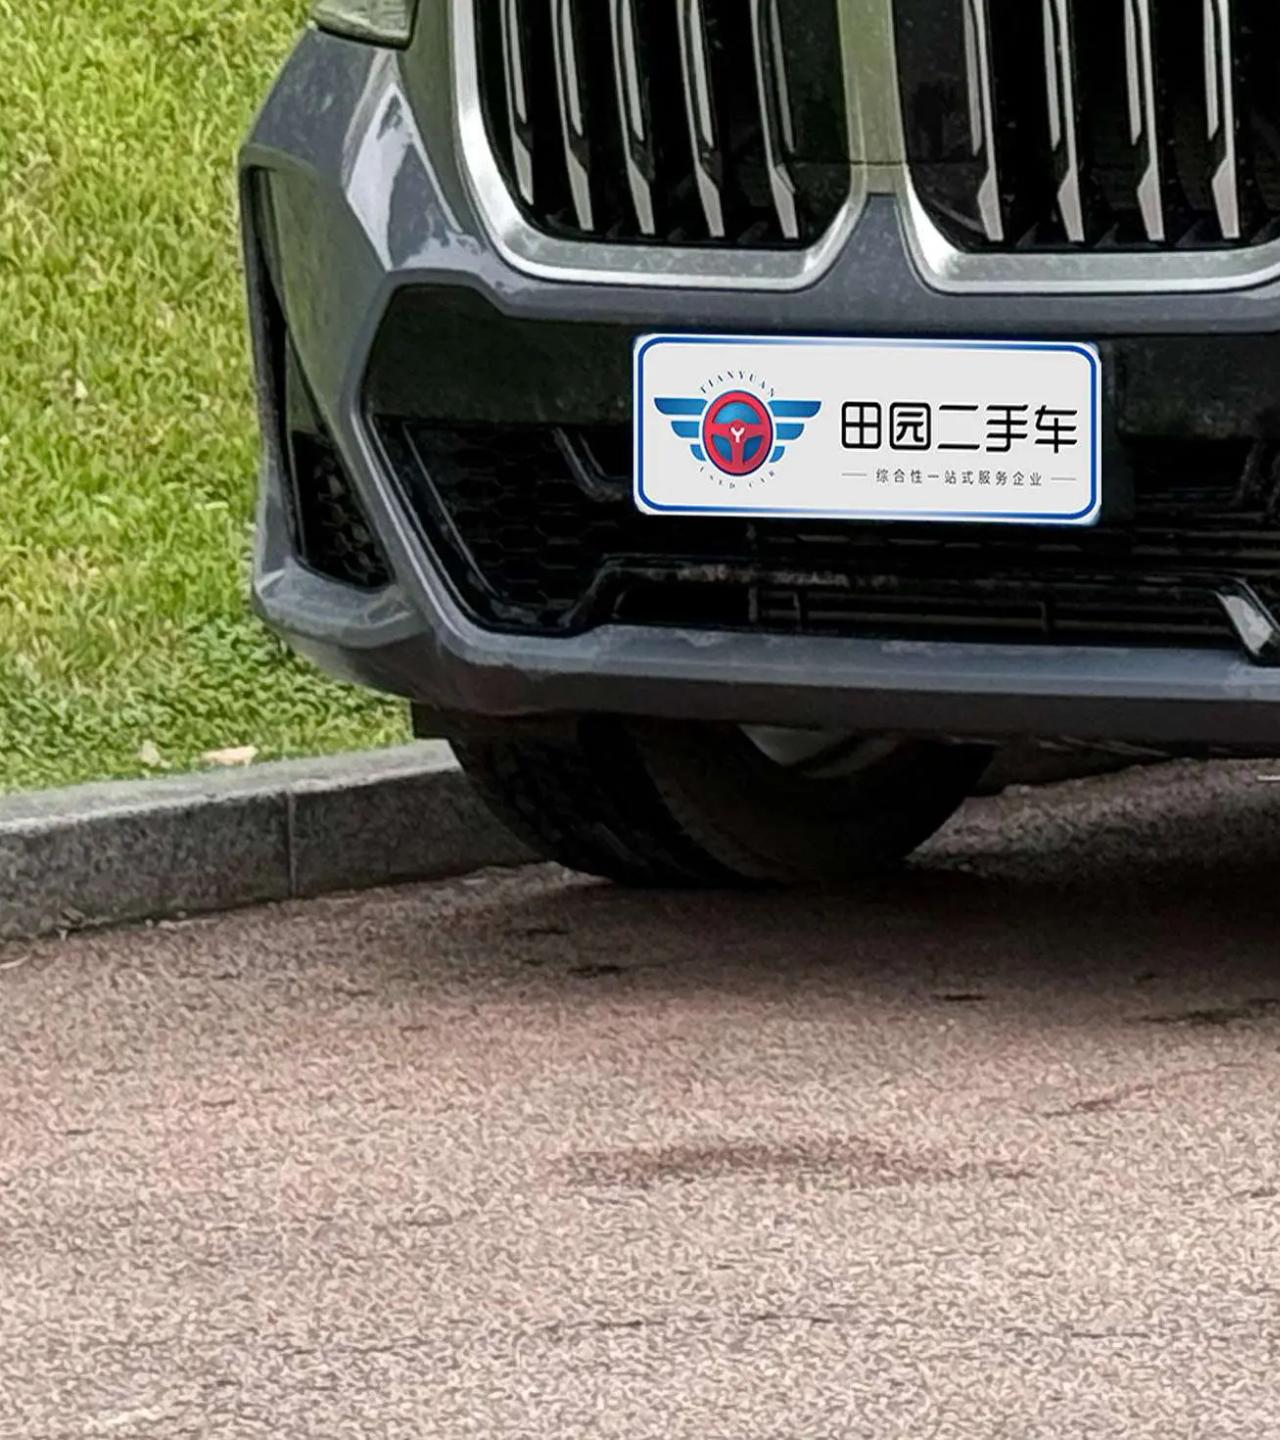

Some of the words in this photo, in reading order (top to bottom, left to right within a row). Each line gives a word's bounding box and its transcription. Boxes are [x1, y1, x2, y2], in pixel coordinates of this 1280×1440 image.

[841, 401, 1078, 454] 田园二手车
[875, 468, 1043, 486] 综合性一站式服务企业
